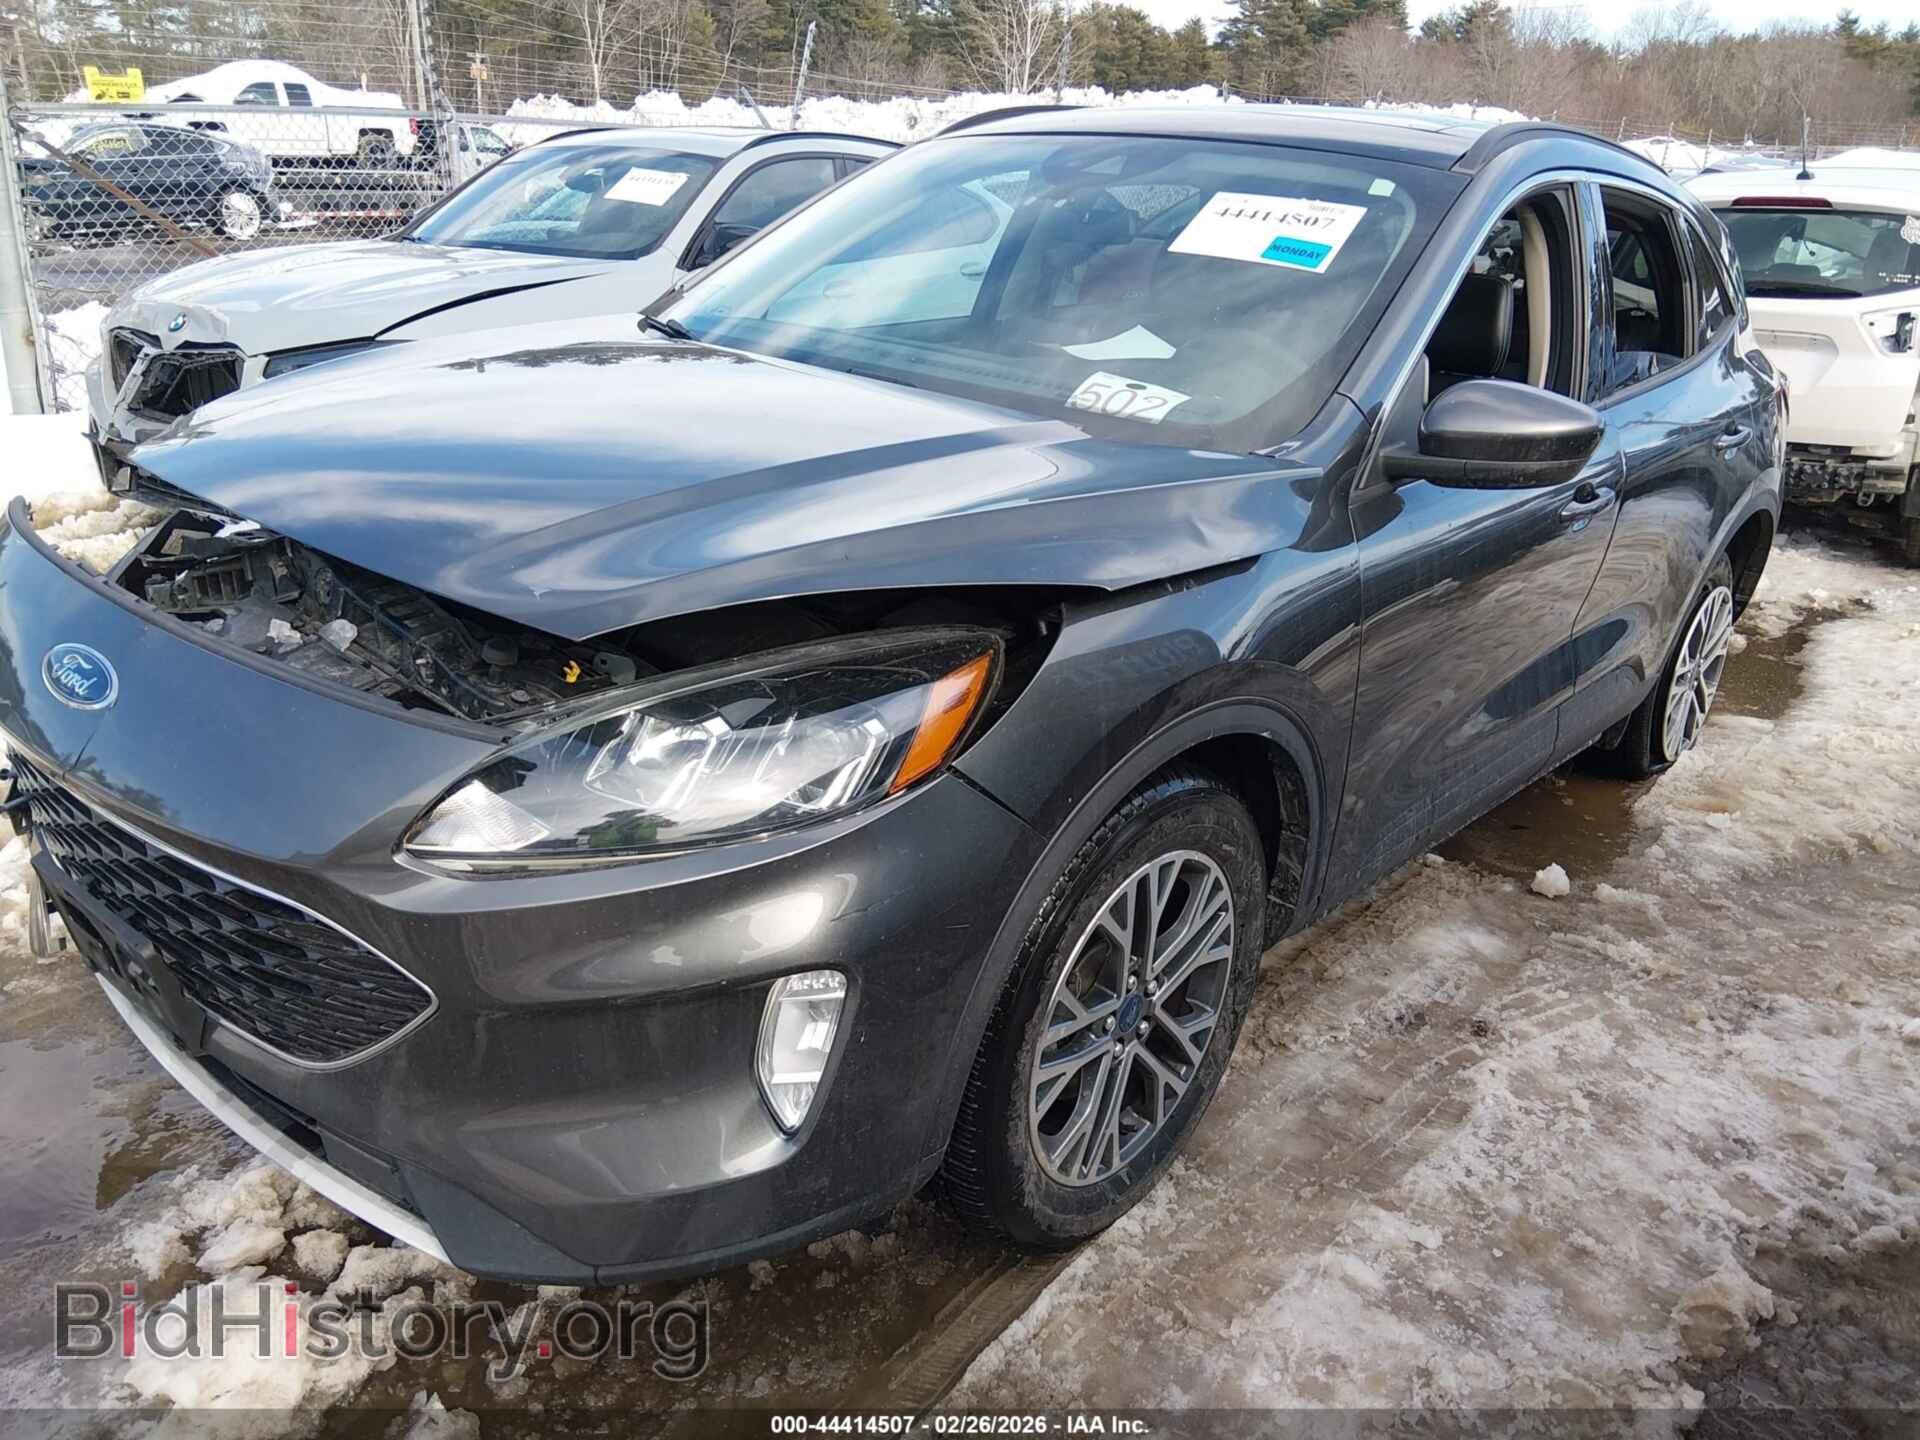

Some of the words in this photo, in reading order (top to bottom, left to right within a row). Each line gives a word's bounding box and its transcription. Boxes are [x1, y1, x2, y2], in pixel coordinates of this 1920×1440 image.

[1271, 243, 1322, 260] MONDAY
[1073, 382, 1168, 420] 502
[51, 654, 98, 695] Ford
